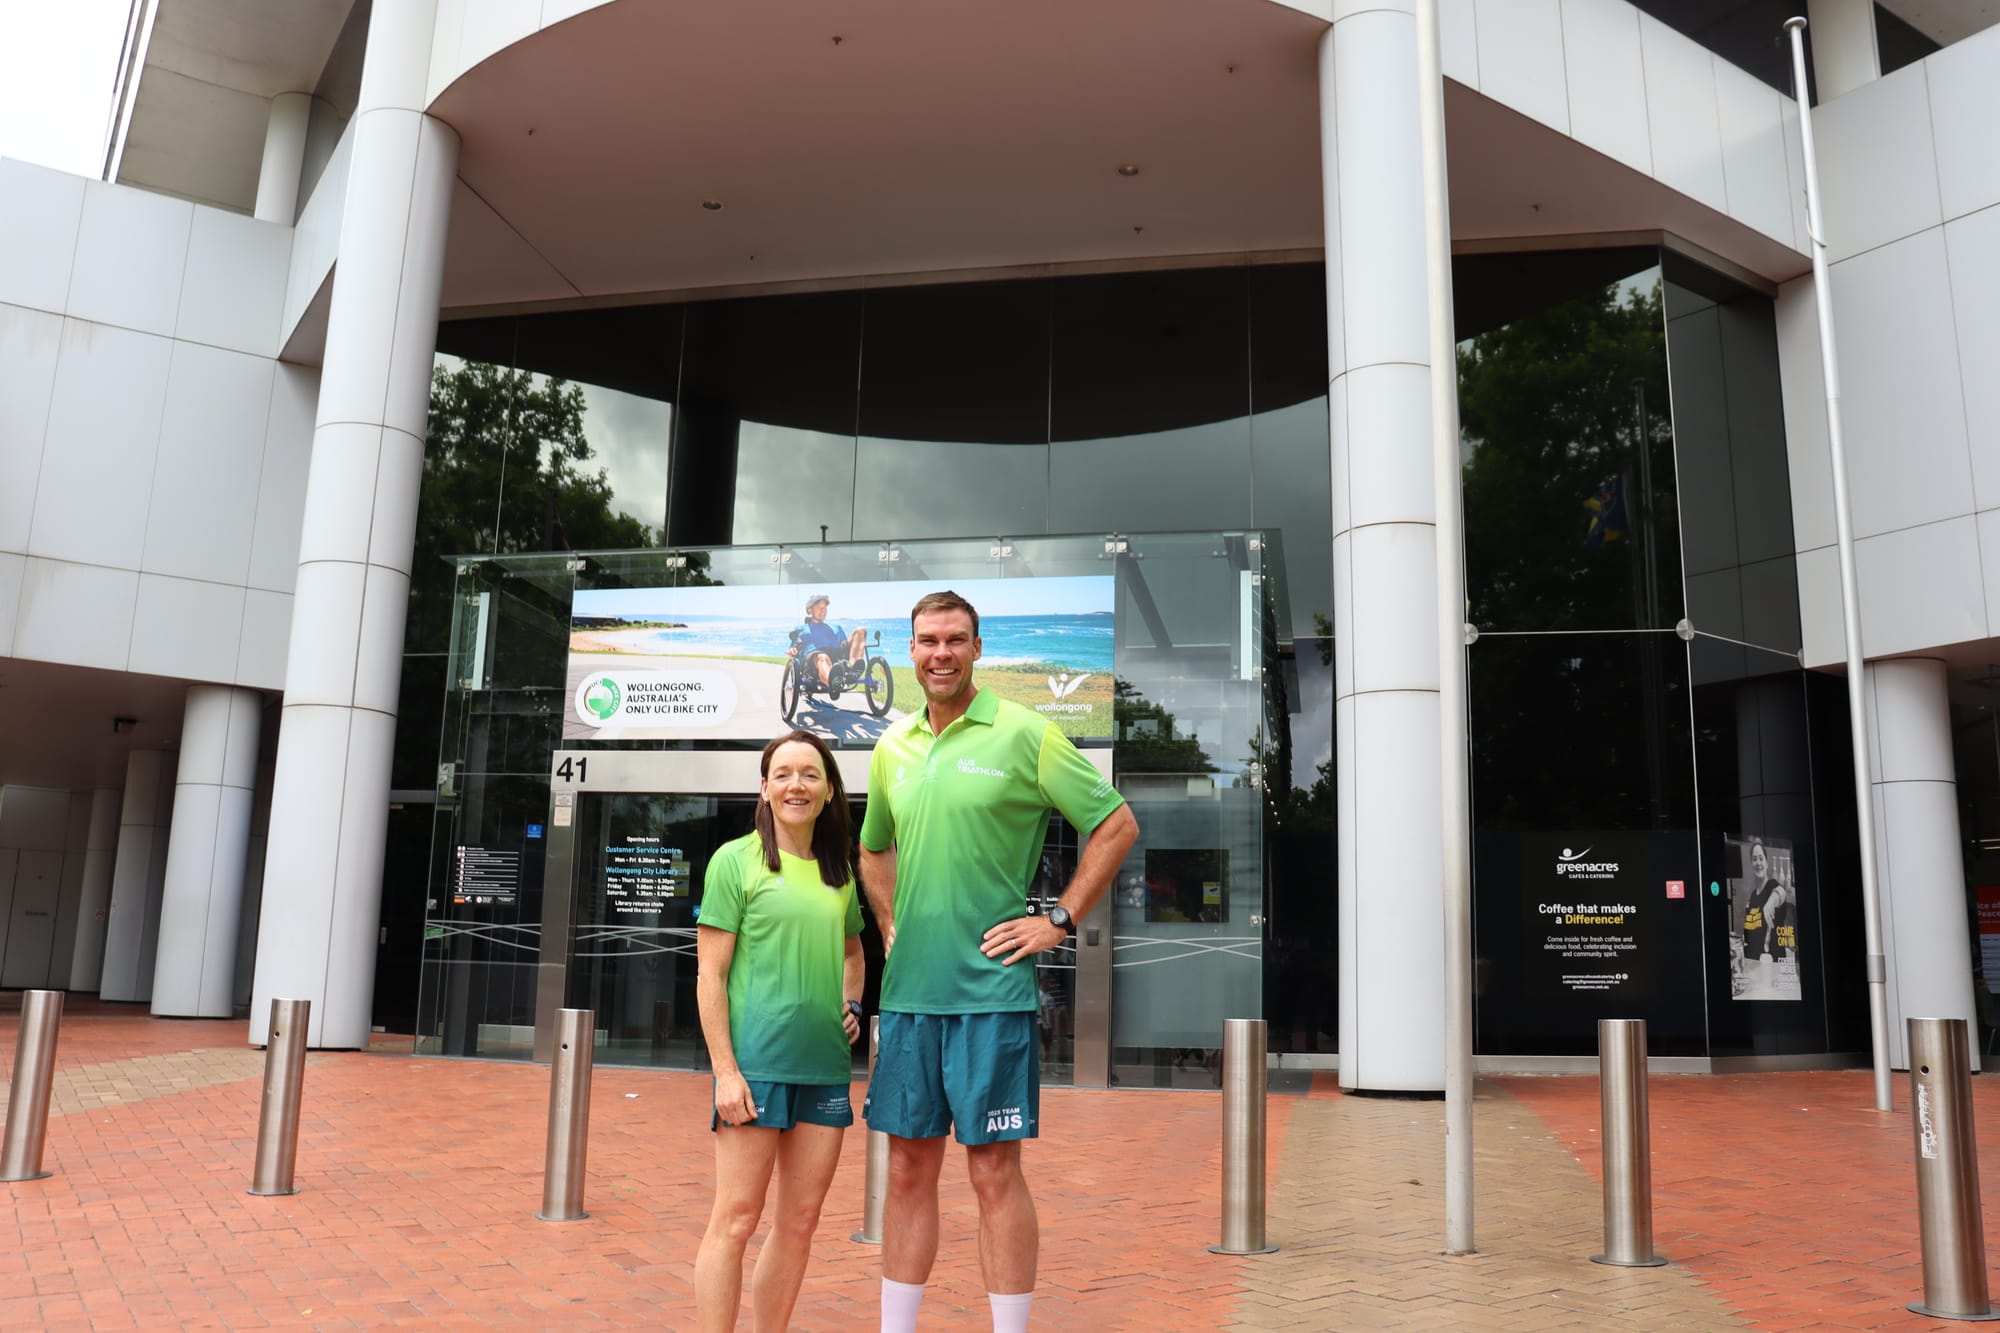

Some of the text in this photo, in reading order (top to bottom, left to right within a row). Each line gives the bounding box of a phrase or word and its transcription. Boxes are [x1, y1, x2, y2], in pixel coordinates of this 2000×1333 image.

[627, 682, 704, 692] WOLLONGONG.
[626, 693, 688, 703] AUSTRALIA'S
[626, 704, 719, 714] ONLY UCI BIKE CITY
[1035, 702, 1092, 713] wollongong
[958, 758, 976, 767] AUS
[556, 757, 587, 783] 41
[958, 766, 1005, 778] TRIATHLON
[605, 846, 635, 854] Customer
[660, 847, 682, 855] Centre
[605, 867, 642, 875] Wollongong
[655, 868, 678, 876] Library
[1556, 863, 1619, 875] greenacres
[1538, 903, 1637, 914] Coffee that makes
[1555, 914, 1624, 925] a Difference!
[1776, 926, 1794, 936] COME
[1777, 937, 1787, 947] ON
[1002, 1107, 1020, 1116] TEAM
[986, 1114, 1023, 1133] AUS
